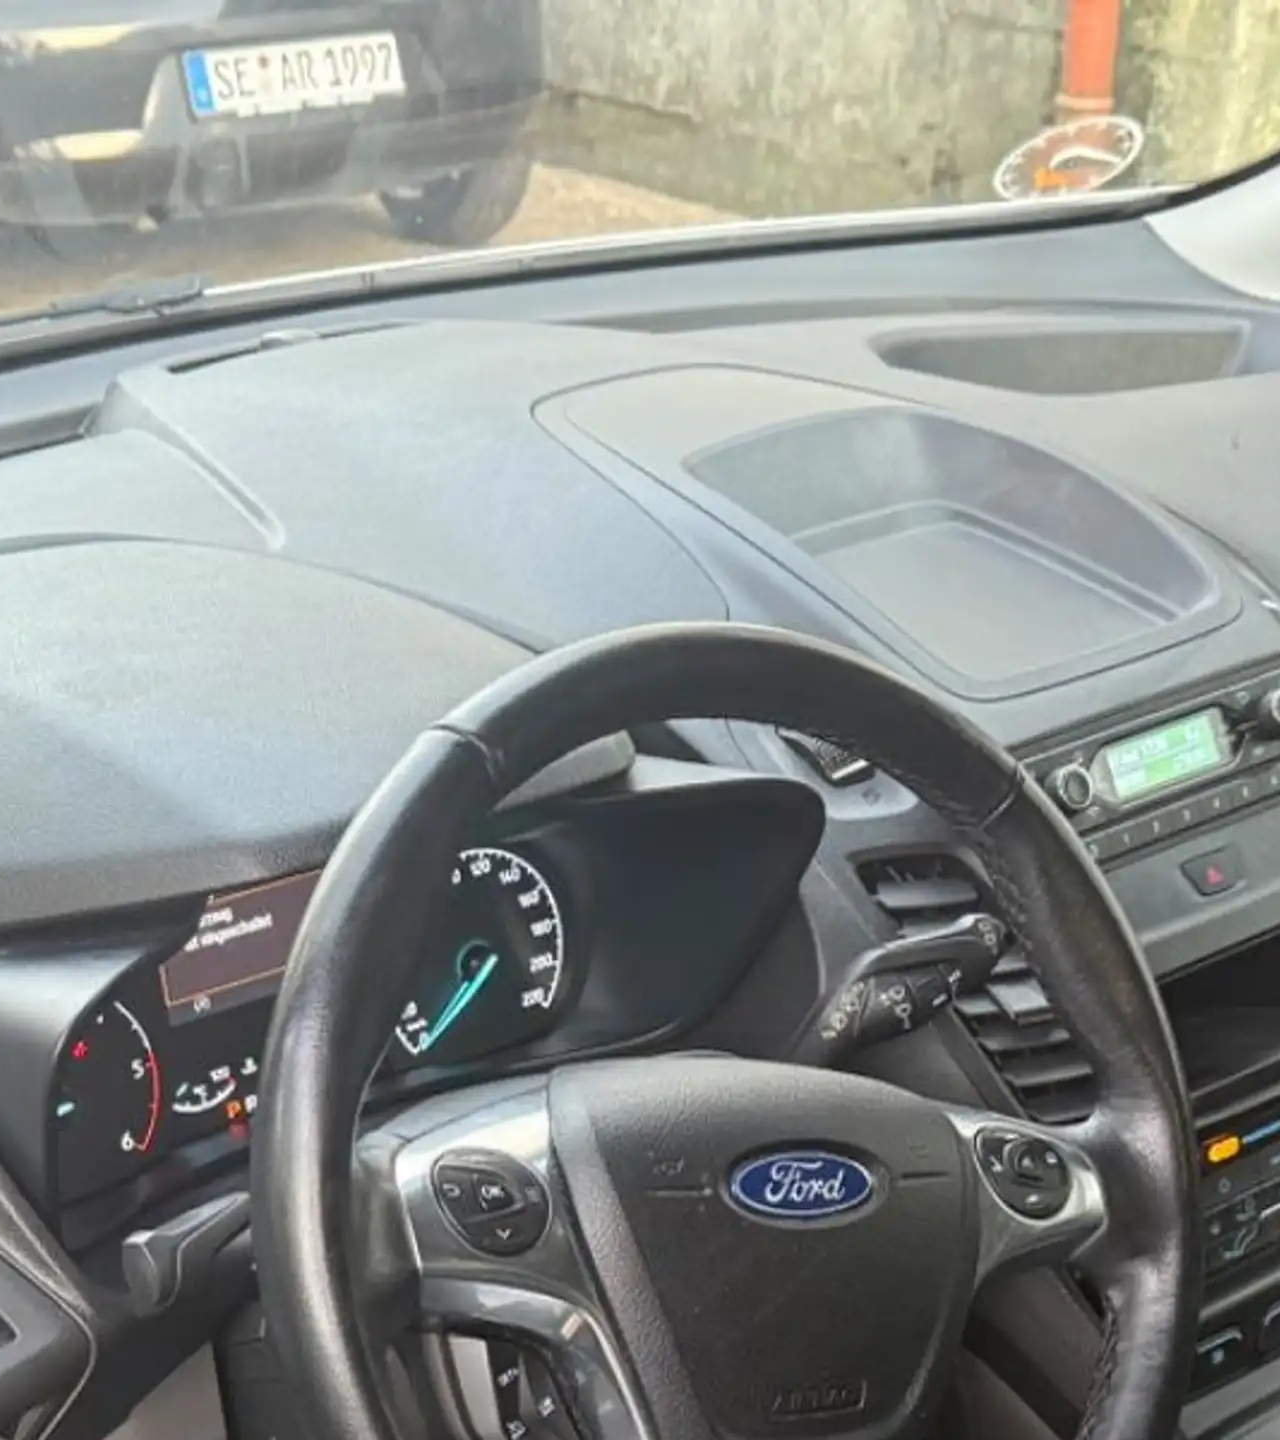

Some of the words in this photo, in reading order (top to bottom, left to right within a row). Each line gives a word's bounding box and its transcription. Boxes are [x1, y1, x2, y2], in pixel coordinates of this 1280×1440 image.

[213, 57, 256, 100] SE
[281, 48, 320, 92] AR
[325, 42, 391, 87] 1997
[131, 1058, 147, 1080] 5
[120, 1130, 135, 1152] 6
[764, 1160, 847, 1203] Ford
